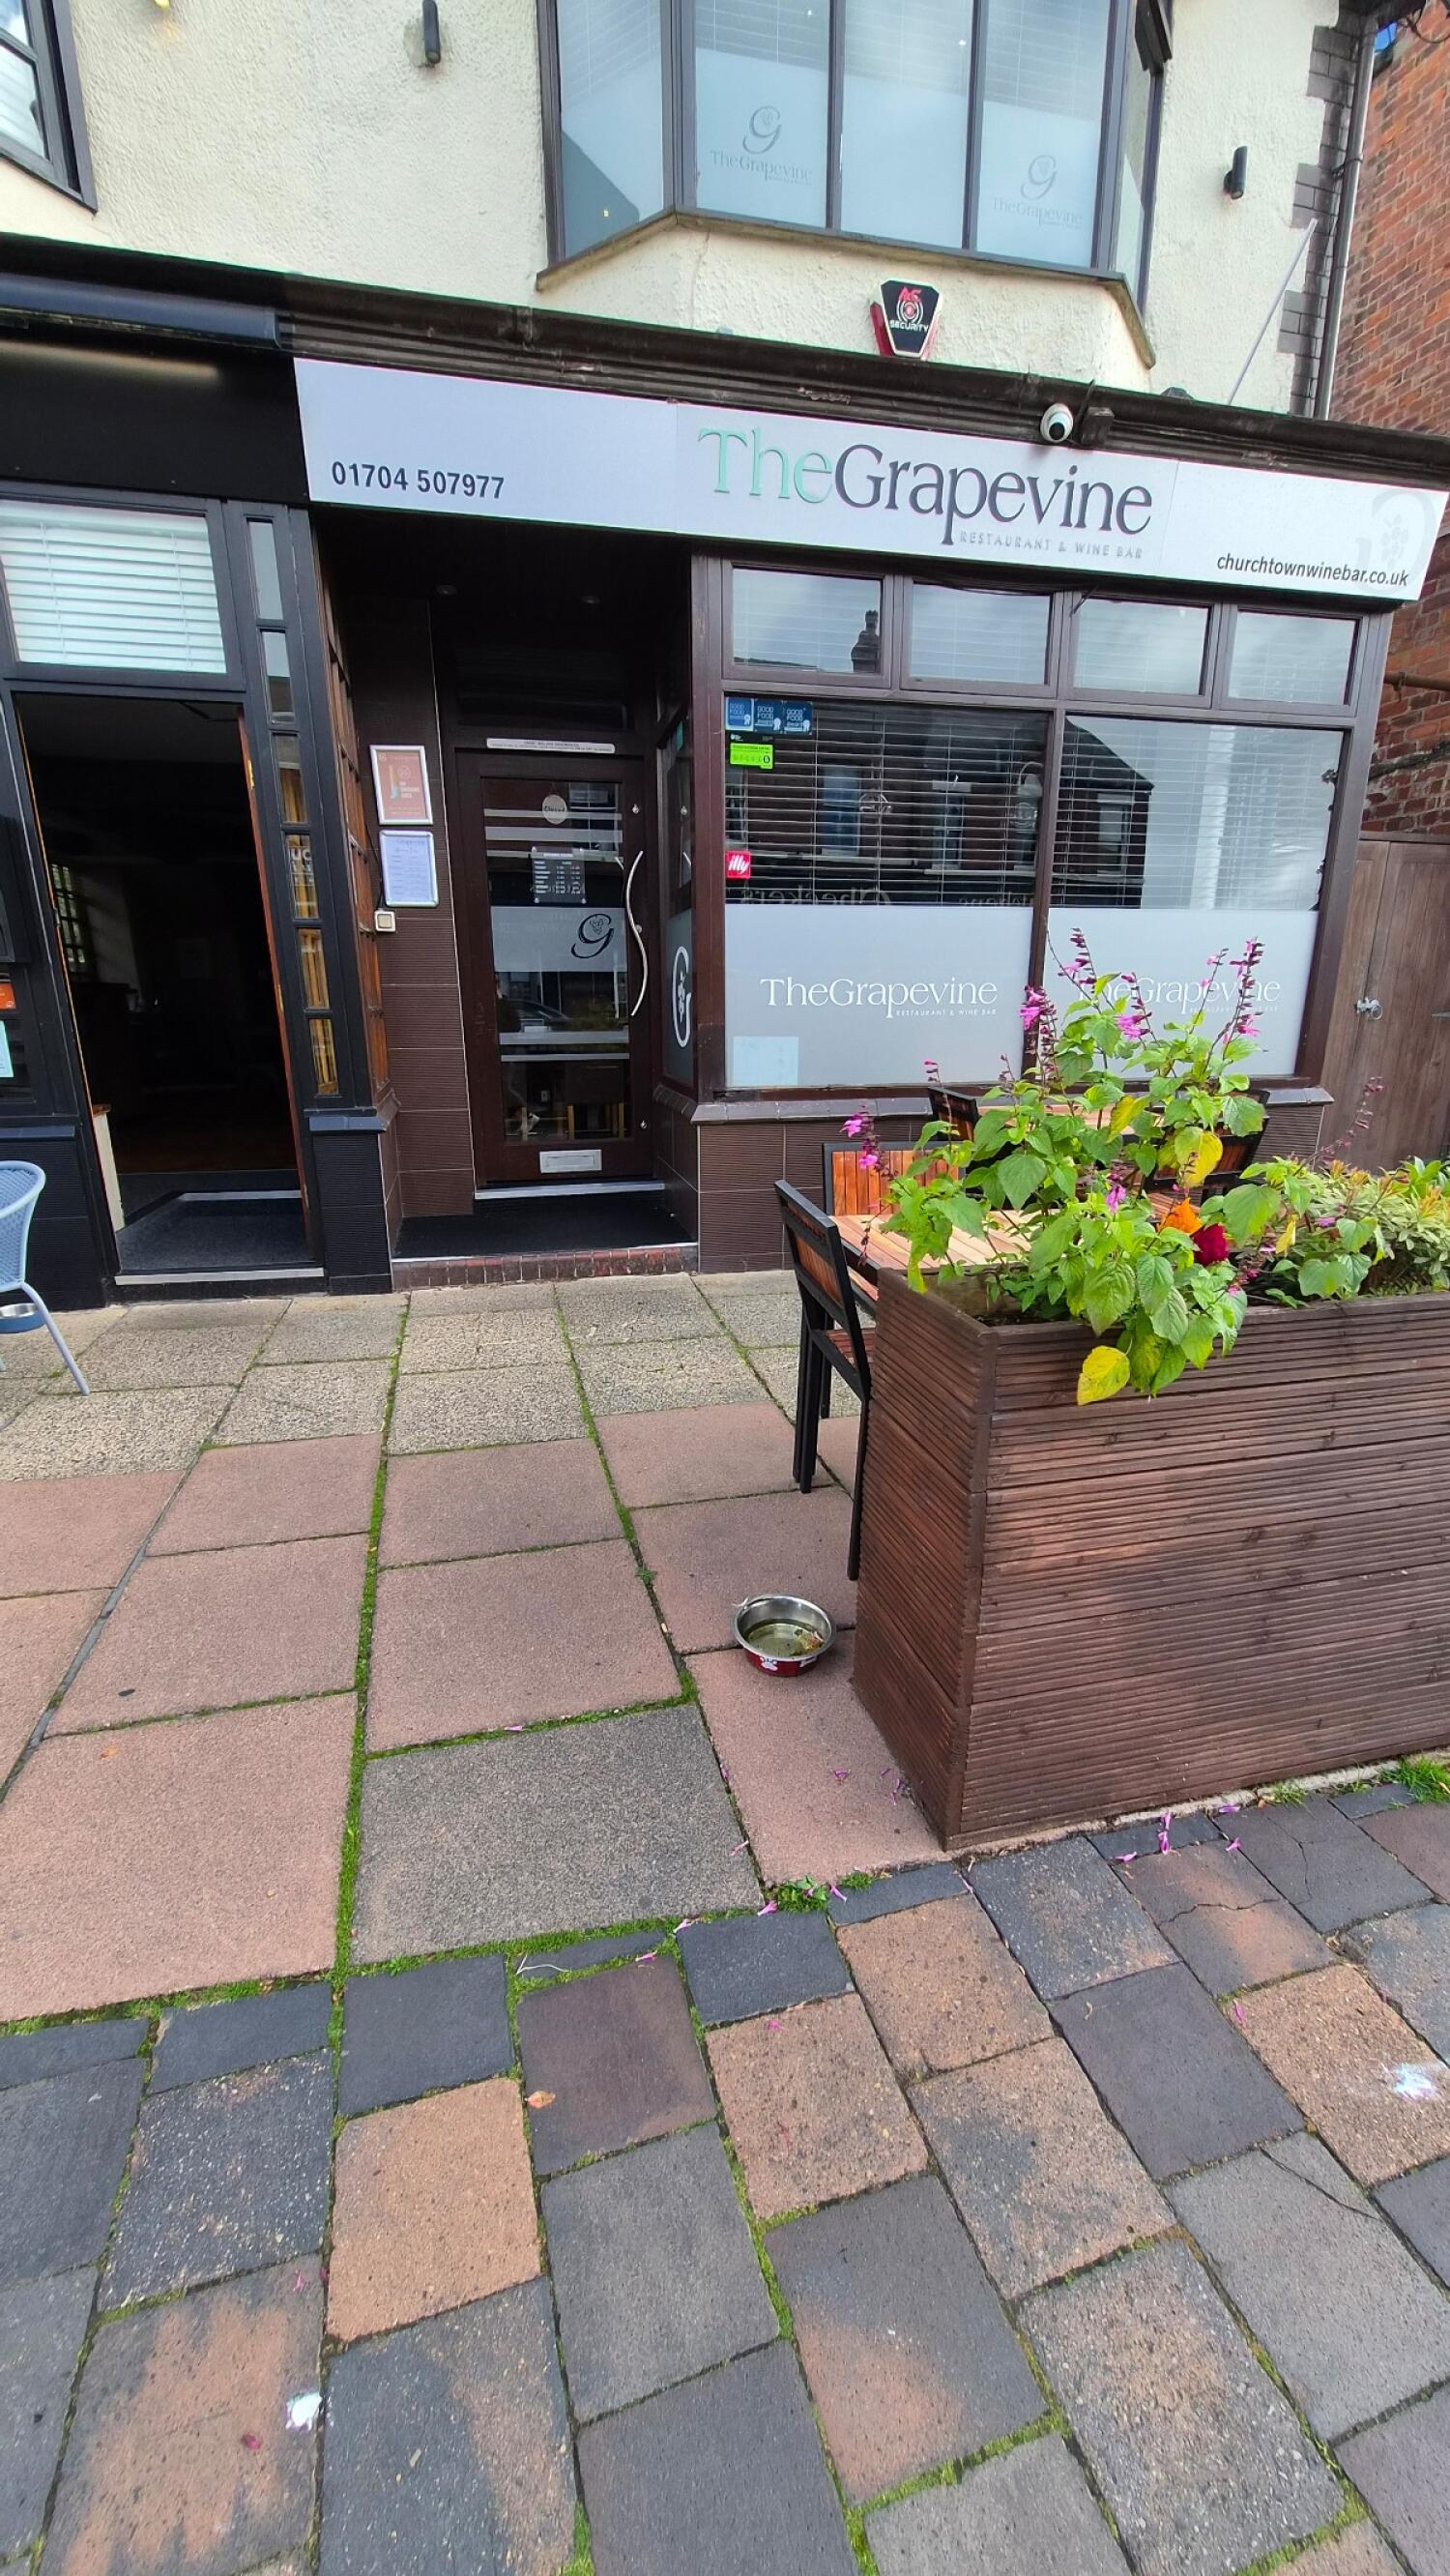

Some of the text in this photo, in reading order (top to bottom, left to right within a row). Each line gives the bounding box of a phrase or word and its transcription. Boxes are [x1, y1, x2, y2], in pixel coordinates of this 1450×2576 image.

[889, 319, 929, 333] SECURITY
[332, 460, 505, 499] 01704 507977
[959, 530, 1144, 559] RESTAURANT & WINE BAR
[1216, 552, 1410, 587] churchtownwinebar.co.uk
[728, 854, 750, 875] illy
[759, 976, 999, 1019] TheGrapevine
